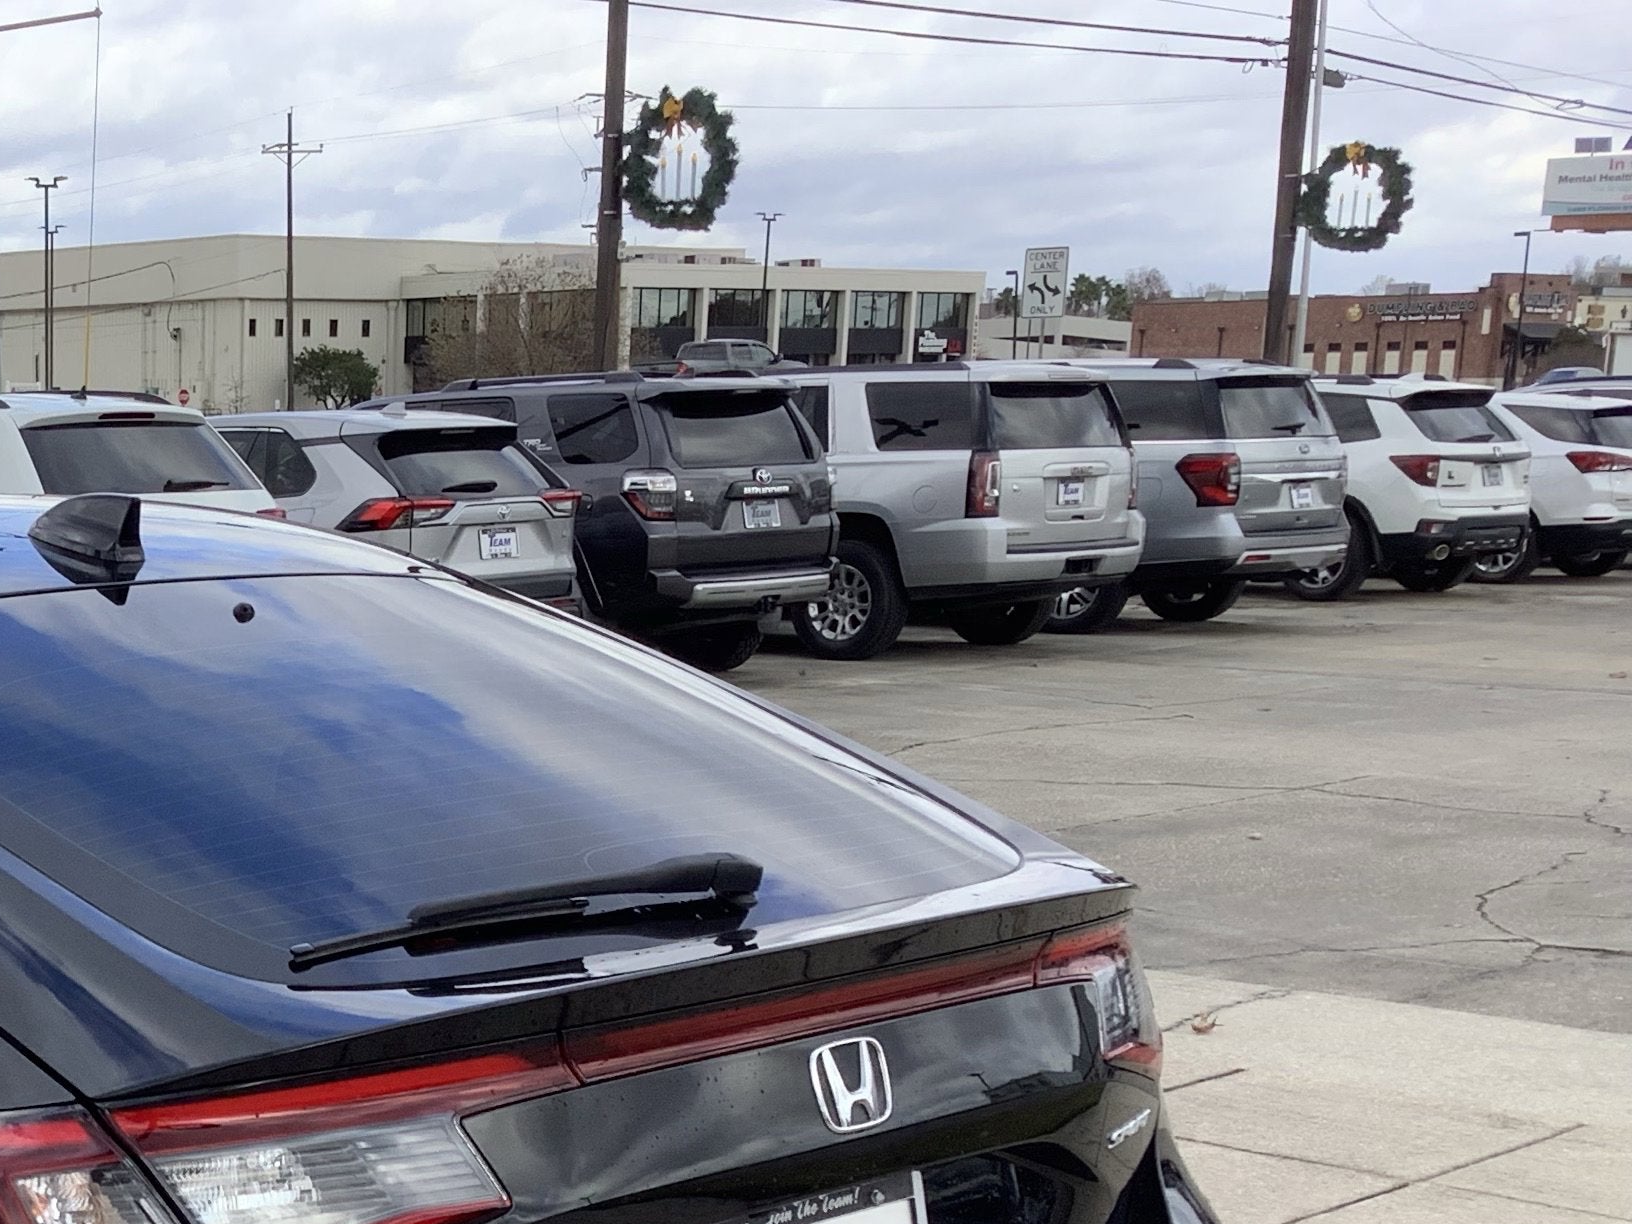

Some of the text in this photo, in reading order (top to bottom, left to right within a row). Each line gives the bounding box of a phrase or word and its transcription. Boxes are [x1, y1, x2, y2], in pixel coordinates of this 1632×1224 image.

[1558, 175, 1597, 184] Mental
[1029, 251, 1065, 261] CENTER
[1033, 261, 1059, 271] LANE
[1030, 305, 1056, 315] ONLY
[1368, 302, 1434, 315] DUMPLING
[488, 531, 512, 547] TEAM
[793, 1199, 820, 1220] The
[818, 1186, 861, 1214] Team!
